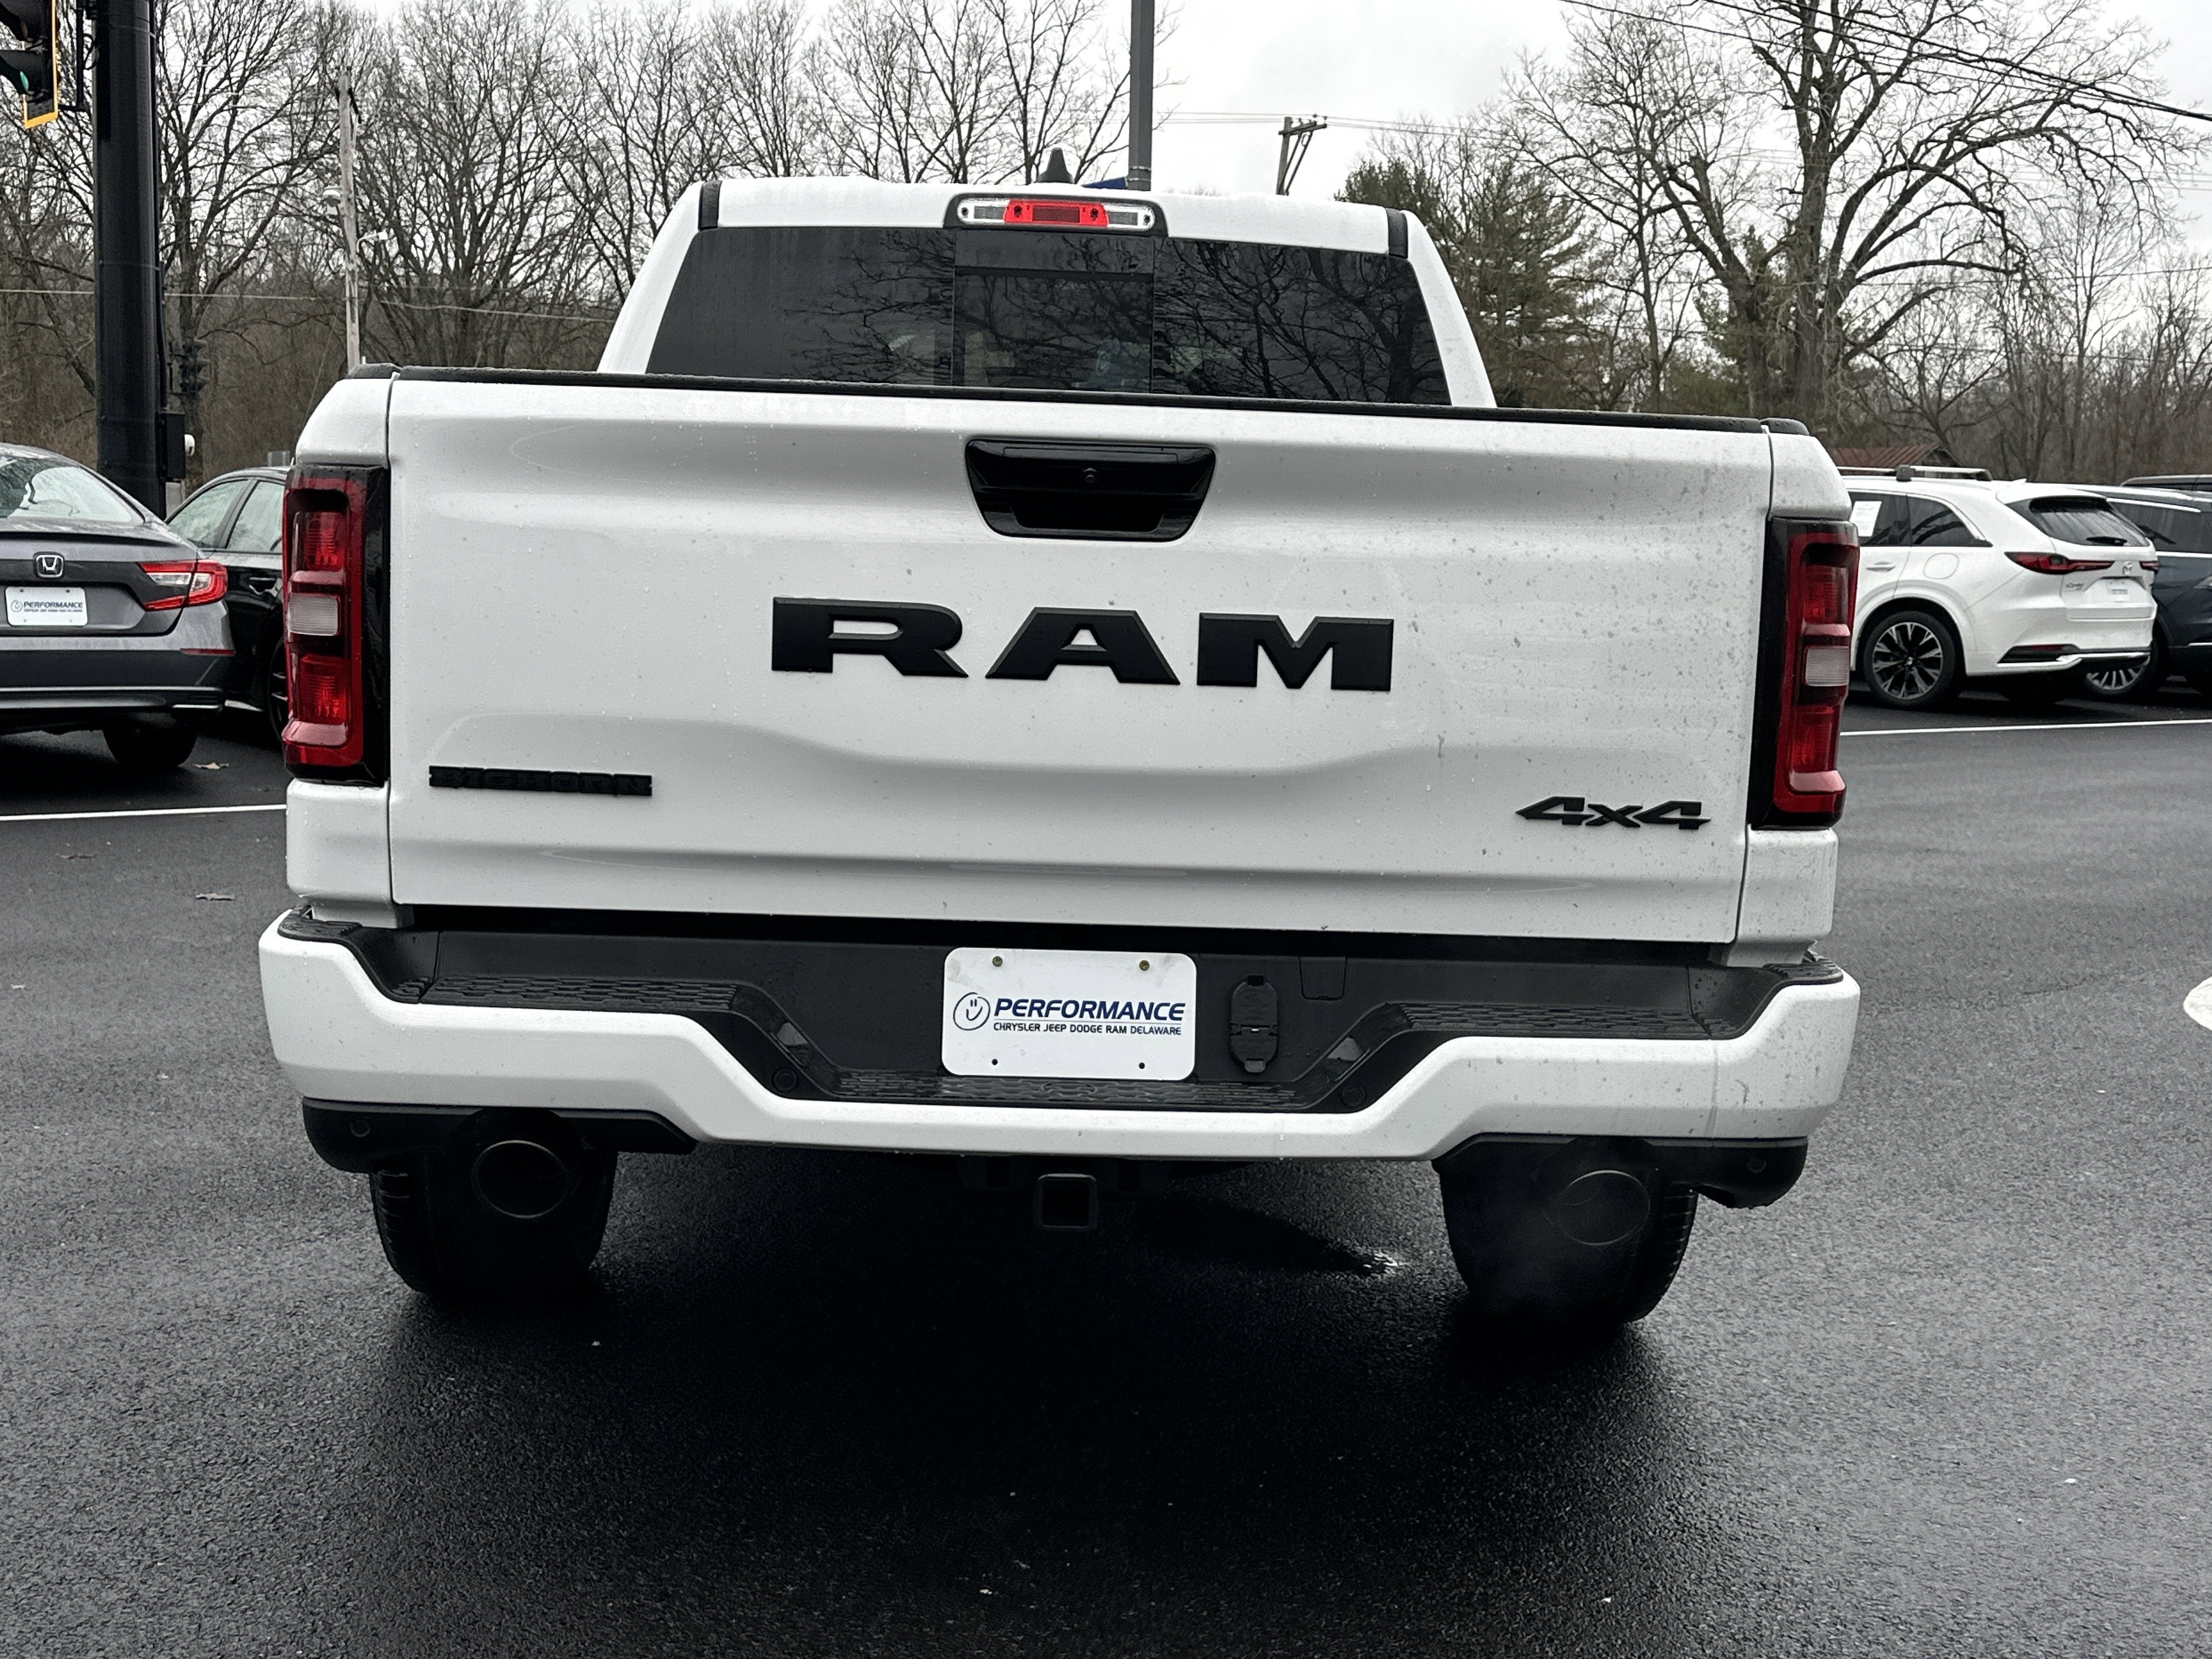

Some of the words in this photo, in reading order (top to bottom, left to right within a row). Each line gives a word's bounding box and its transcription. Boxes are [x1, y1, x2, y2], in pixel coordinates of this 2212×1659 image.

[771, 596, 1394, 692] RAM
[994, 998, 1186, 1021] PERFORMANCE
[994, 1022, 1041, 1032] CHRYSLER
[1043, 1023, 1066, 1032] JEEP
[1070, 1024, 1103, 1034] DODGE
[1105, 1025, 1127, 1034] RAM
[1130, 1026, 1182, 1036] DELAWARE
